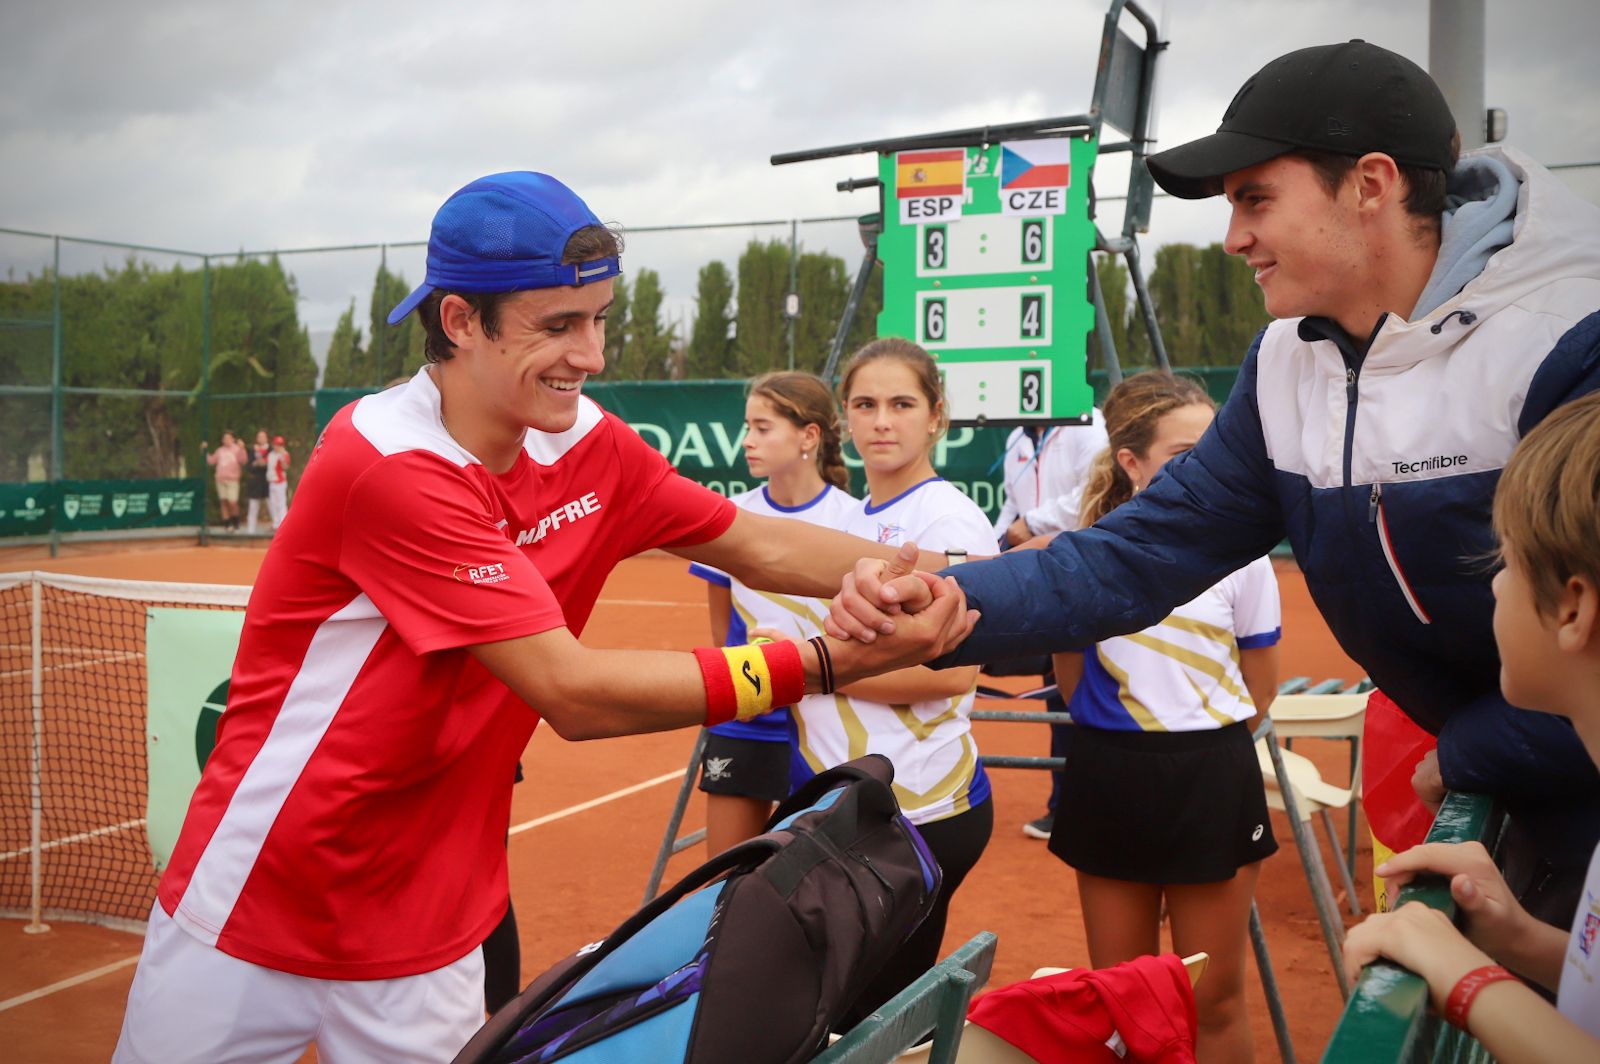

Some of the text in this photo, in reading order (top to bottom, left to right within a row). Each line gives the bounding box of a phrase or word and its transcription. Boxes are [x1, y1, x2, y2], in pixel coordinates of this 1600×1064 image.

[908, 189, 1059, 219] ESP CZE
[927, 230, 944, 268] 3
[1024, 224, 1042, 262] 6
[927, 302, 945, 339] 6
[1022, 300, 1040, 337] 4
[1022, 374, 1040, 412] 3
[628, 421, 749, 468] DAV
[1391, 455, 1468, 475] Tecnifibre
[468, 563, 503, 580] RFET
